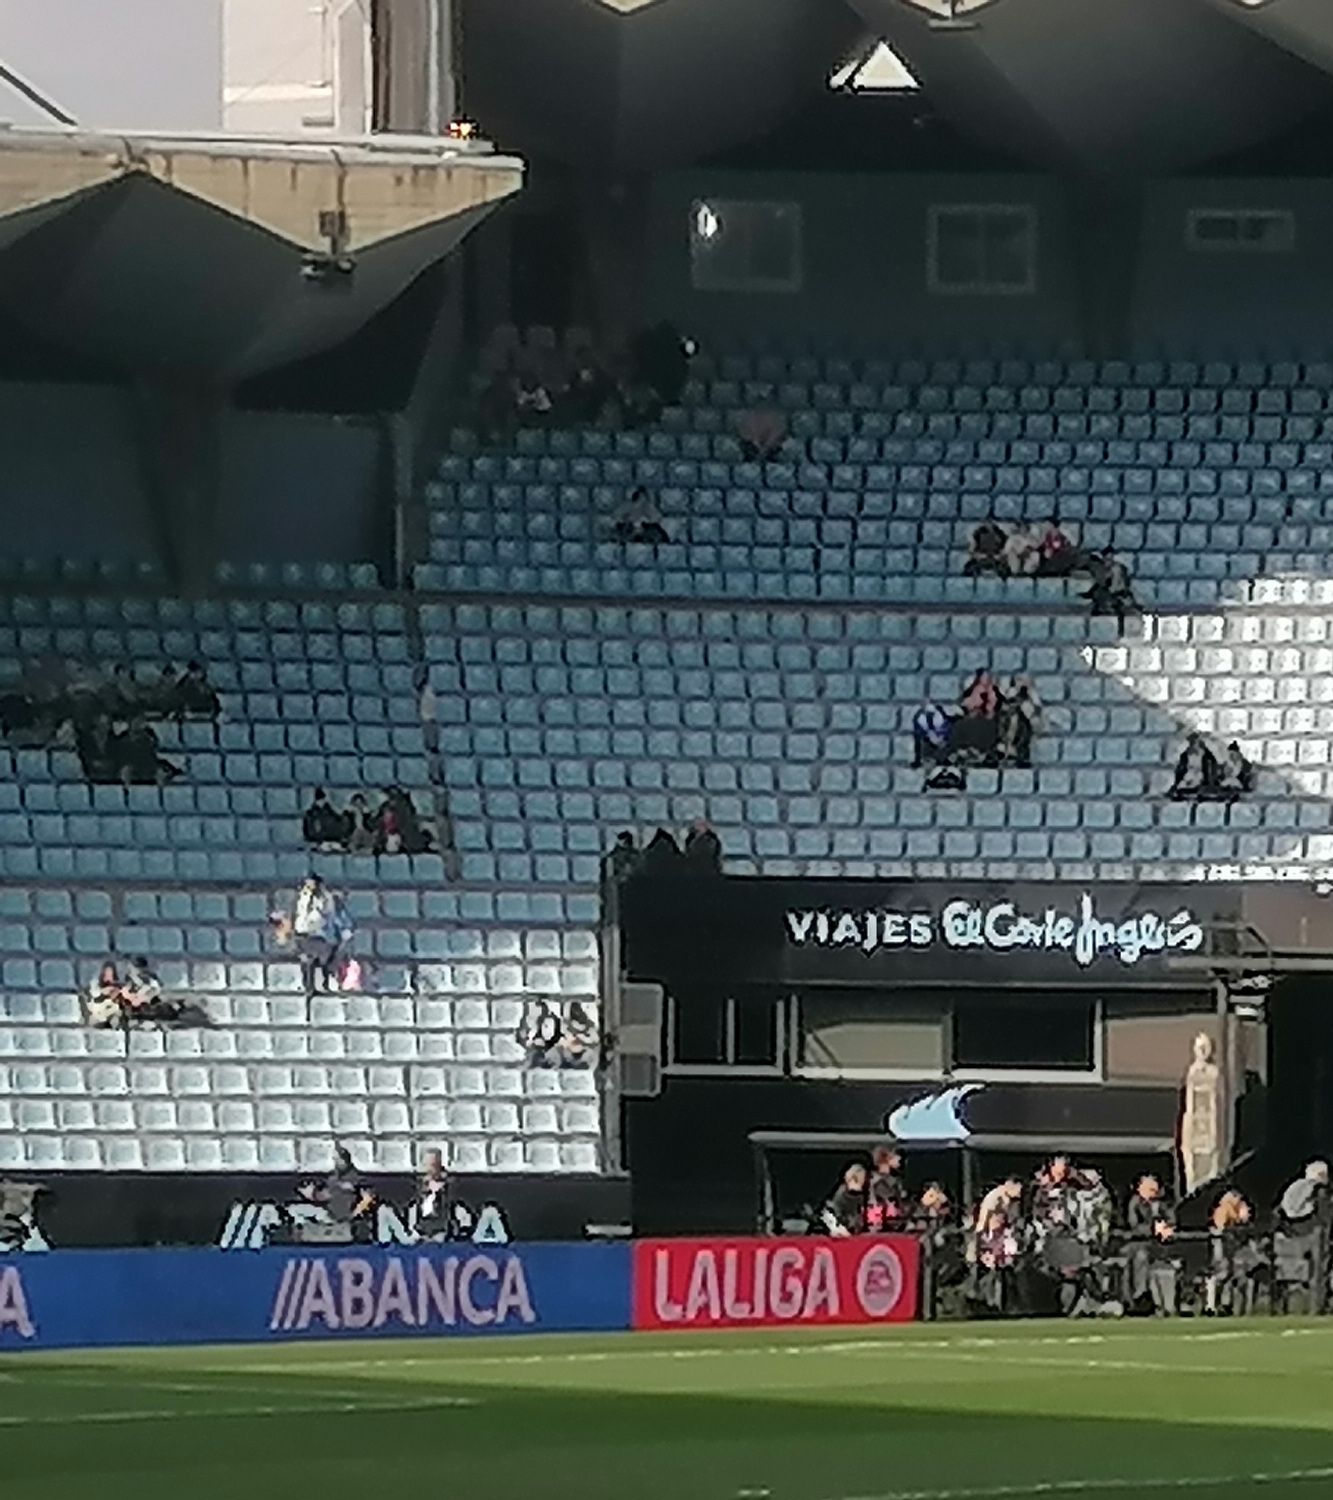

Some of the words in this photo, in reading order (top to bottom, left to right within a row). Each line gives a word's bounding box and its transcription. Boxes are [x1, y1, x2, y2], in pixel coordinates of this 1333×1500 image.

[788, 910, 934, 950] VIAJES
[943, 902, 984, 945] El
[655, 1246, 841, 1321] LALIGA
